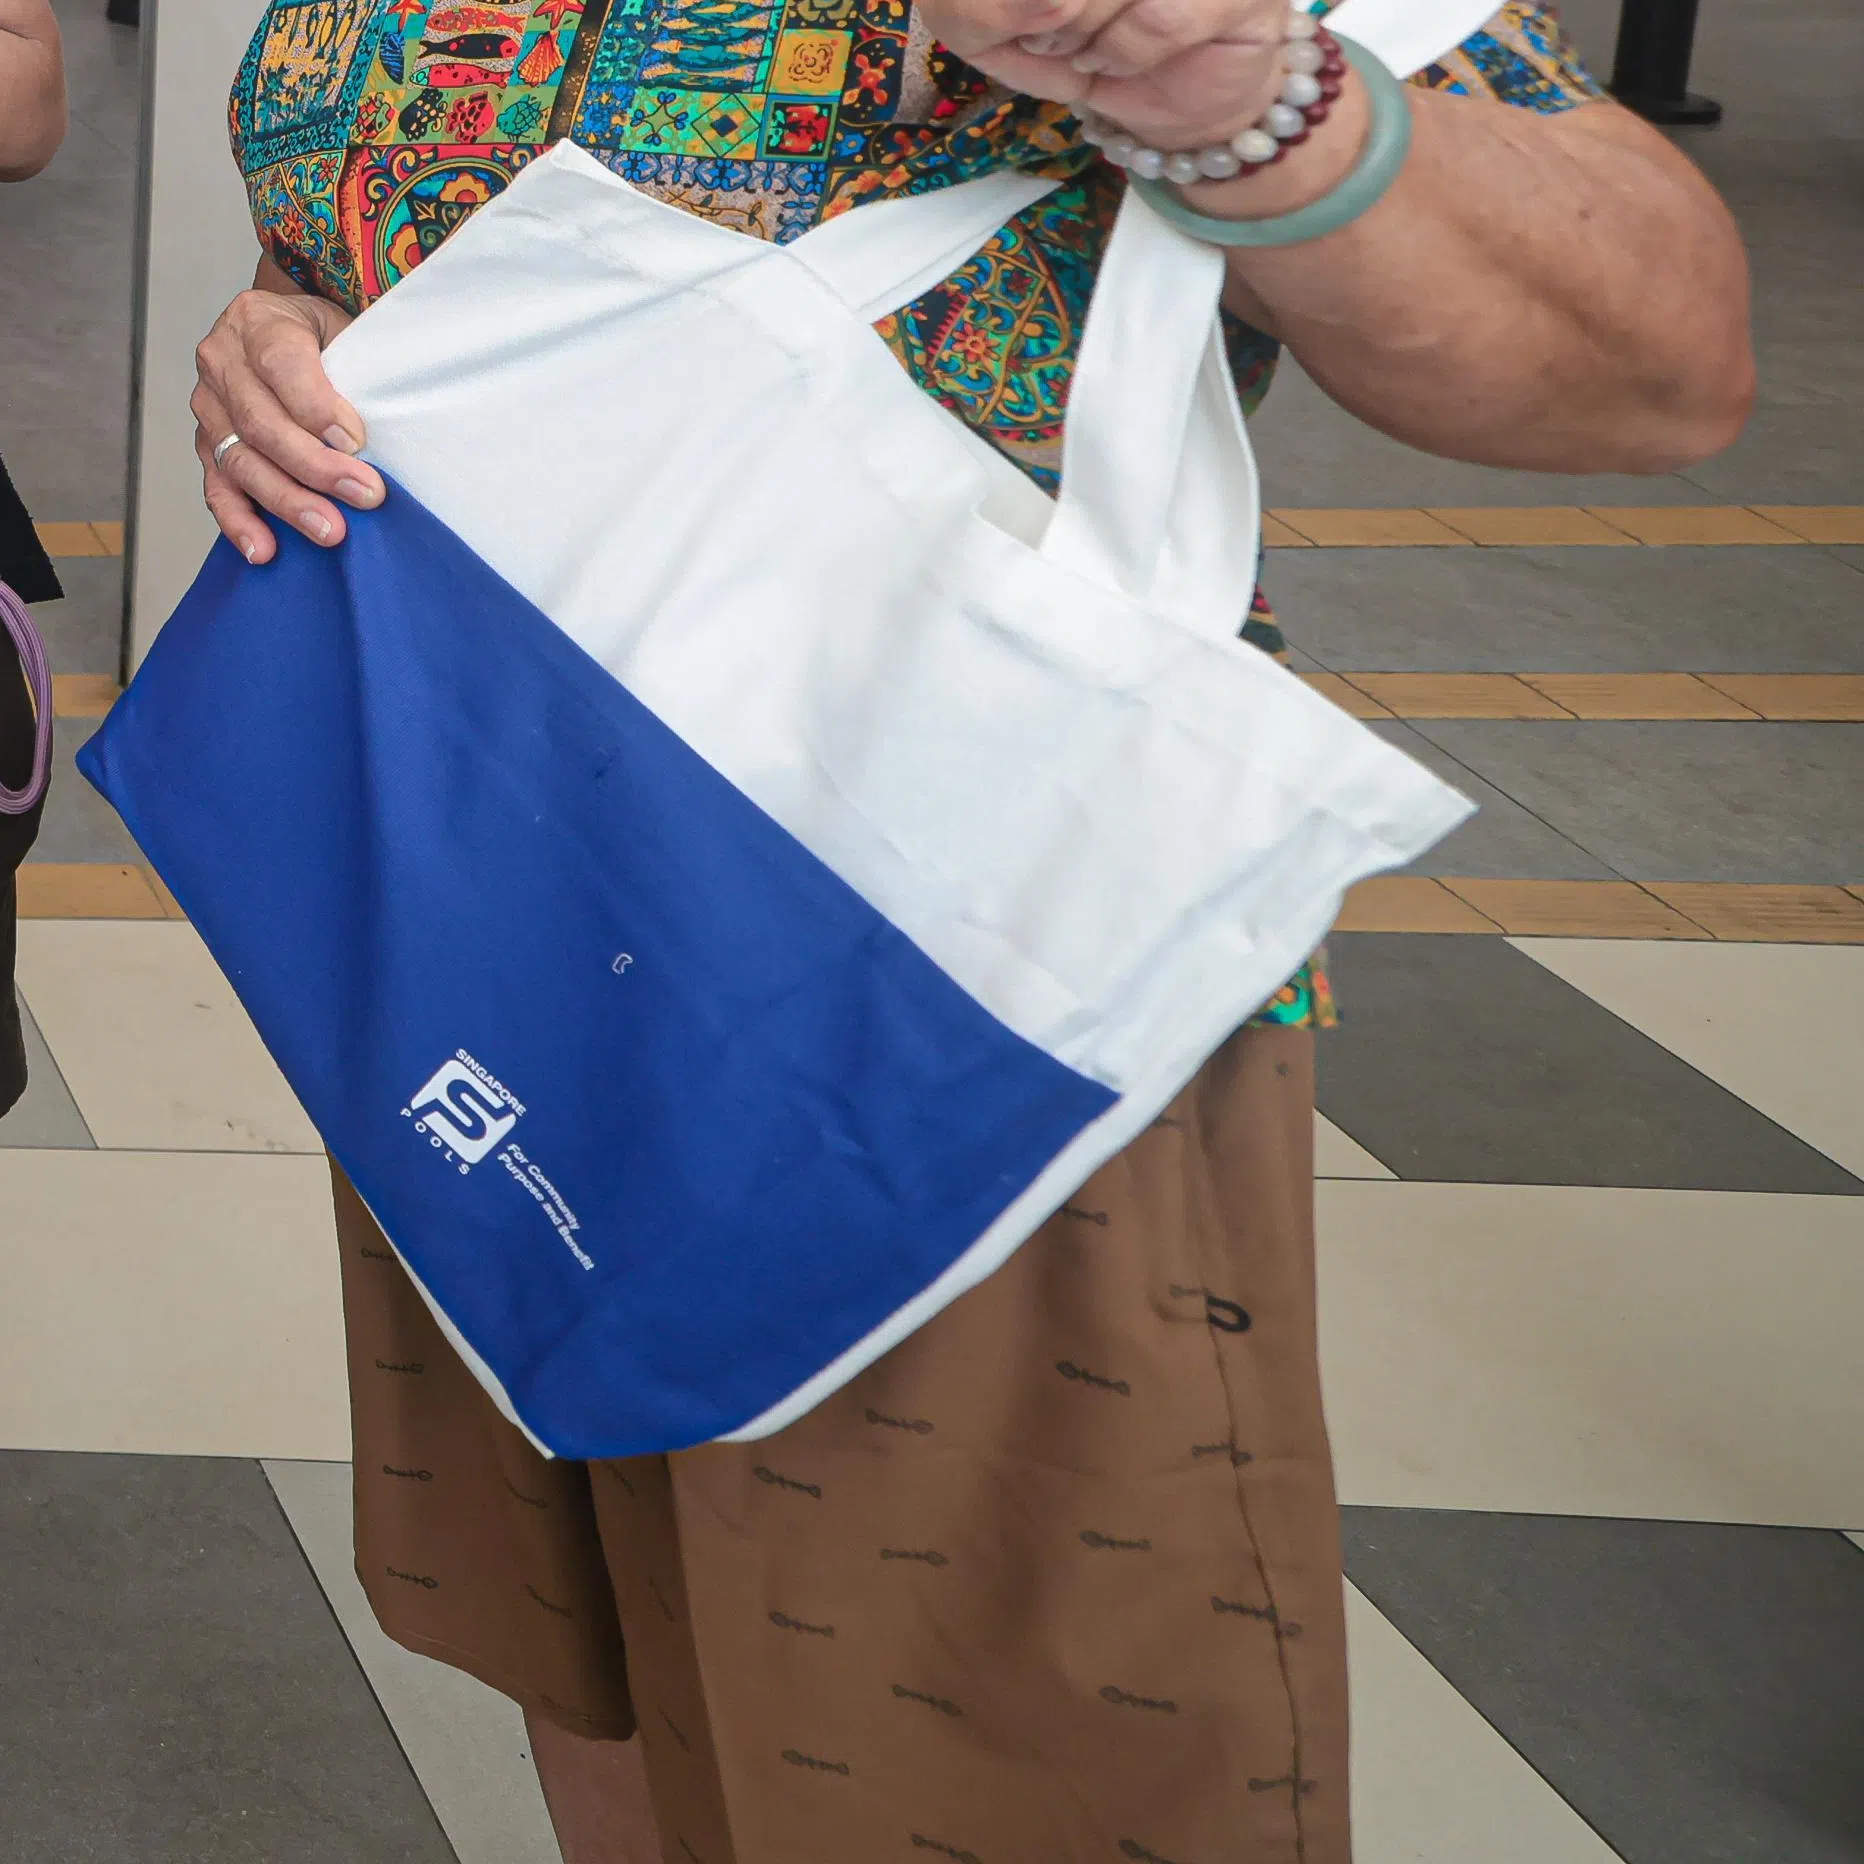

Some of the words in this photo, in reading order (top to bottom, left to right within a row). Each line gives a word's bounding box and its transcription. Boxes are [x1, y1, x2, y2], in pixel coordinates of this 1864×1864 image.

[456, 1047, 528, 1117] SINGAPORE
[400, 1107, 470, 1176] POOLS
[497, 1152, 545, 1203] Purpose
[542, 1202, 563, 1225] and
[558, 1225, 595, 1272] Benefit
[506, 1142, 529, 1165] For
[527, 1164, 581, 1231] Community
